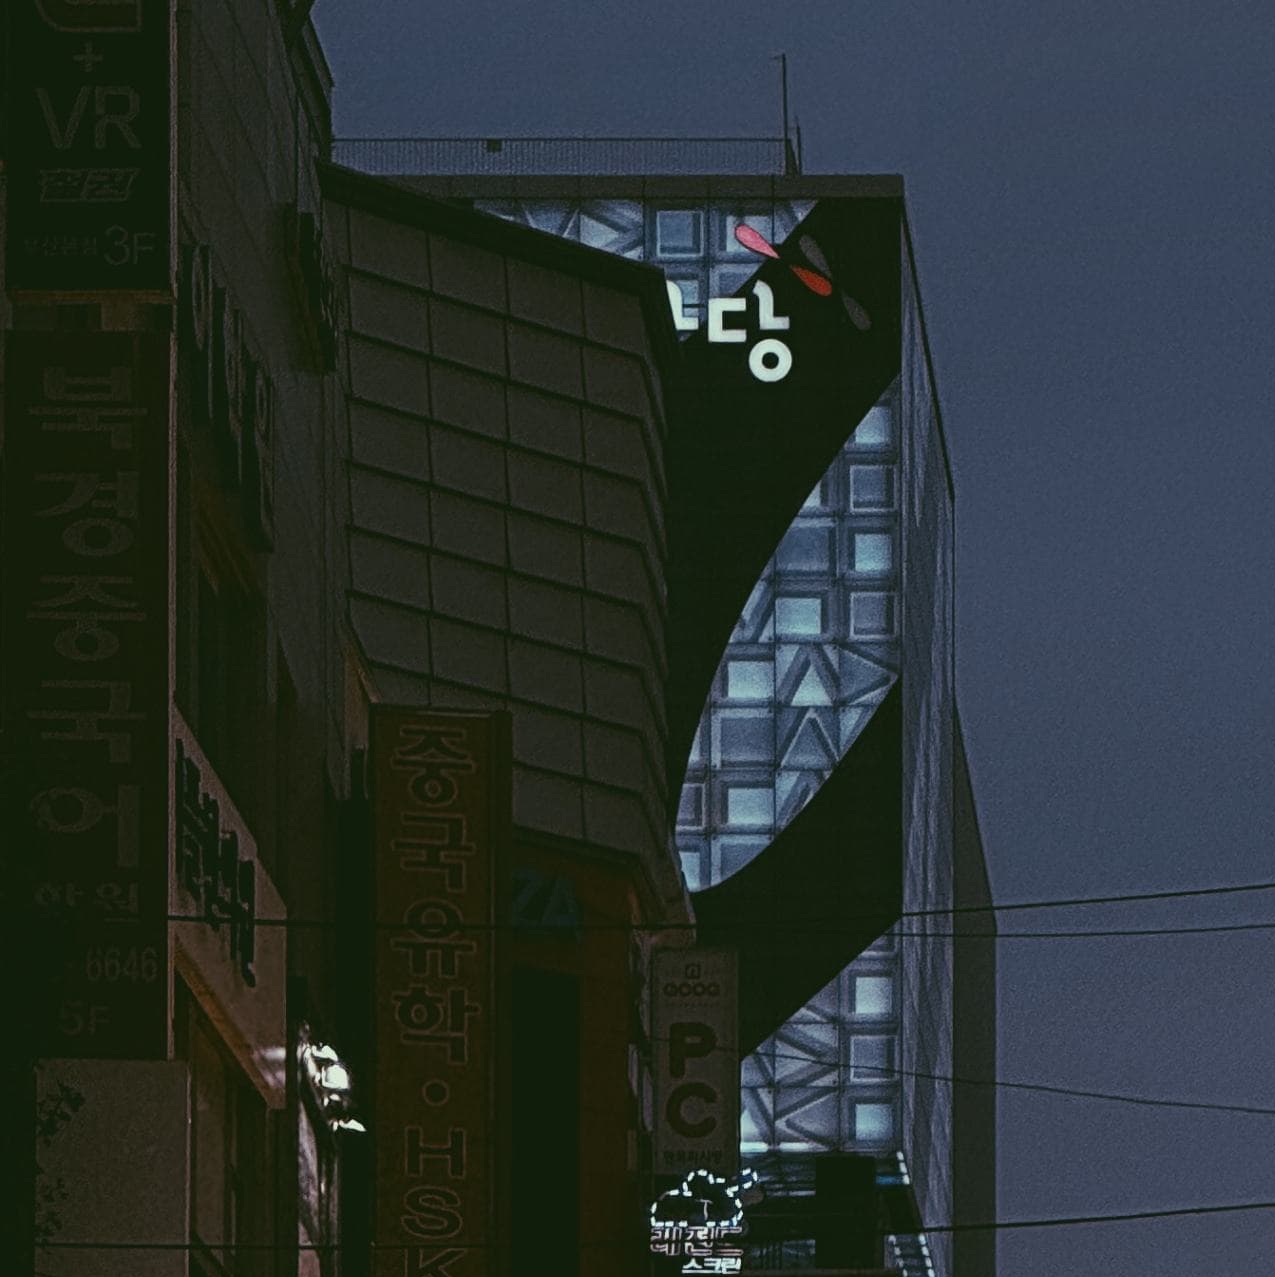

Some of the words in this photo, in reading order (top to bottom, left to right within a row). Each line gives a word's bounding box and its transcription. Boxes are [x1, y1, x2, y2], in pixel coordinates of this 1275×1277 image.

[34, 86, 142, 150] VR
[103, 225, 157, 266] 3F
[28, 364, 148, 868] 북경중국어
[666, 1022, 718, 1138] PC
[681, 1257, 742, 1274] 스크린
